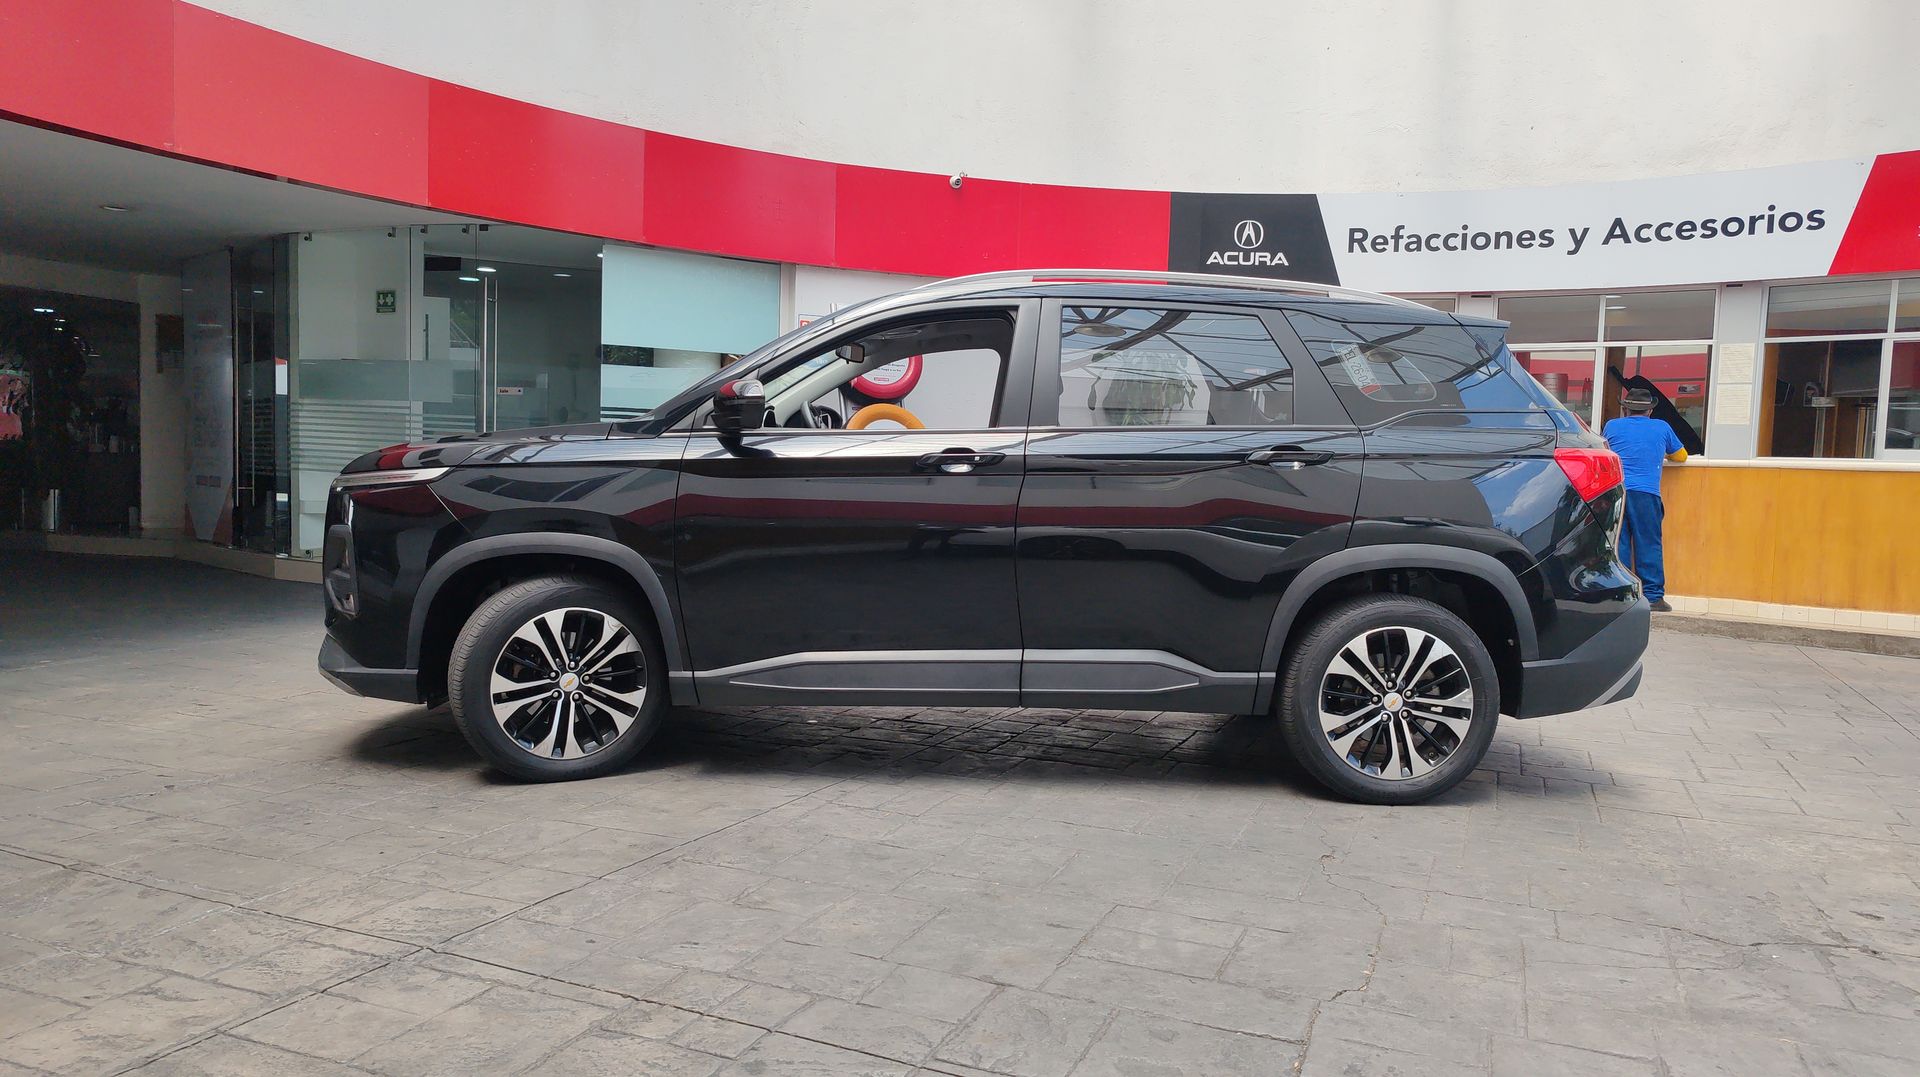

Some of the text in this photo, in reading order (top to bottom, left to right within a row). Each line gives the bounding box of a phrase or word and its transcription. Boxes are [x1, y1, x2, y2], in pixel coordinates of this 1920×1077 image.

[1348, 205, 1825, 255] Refacciones y Accesorios
[1206, 252, 1288, 265] ACURA
